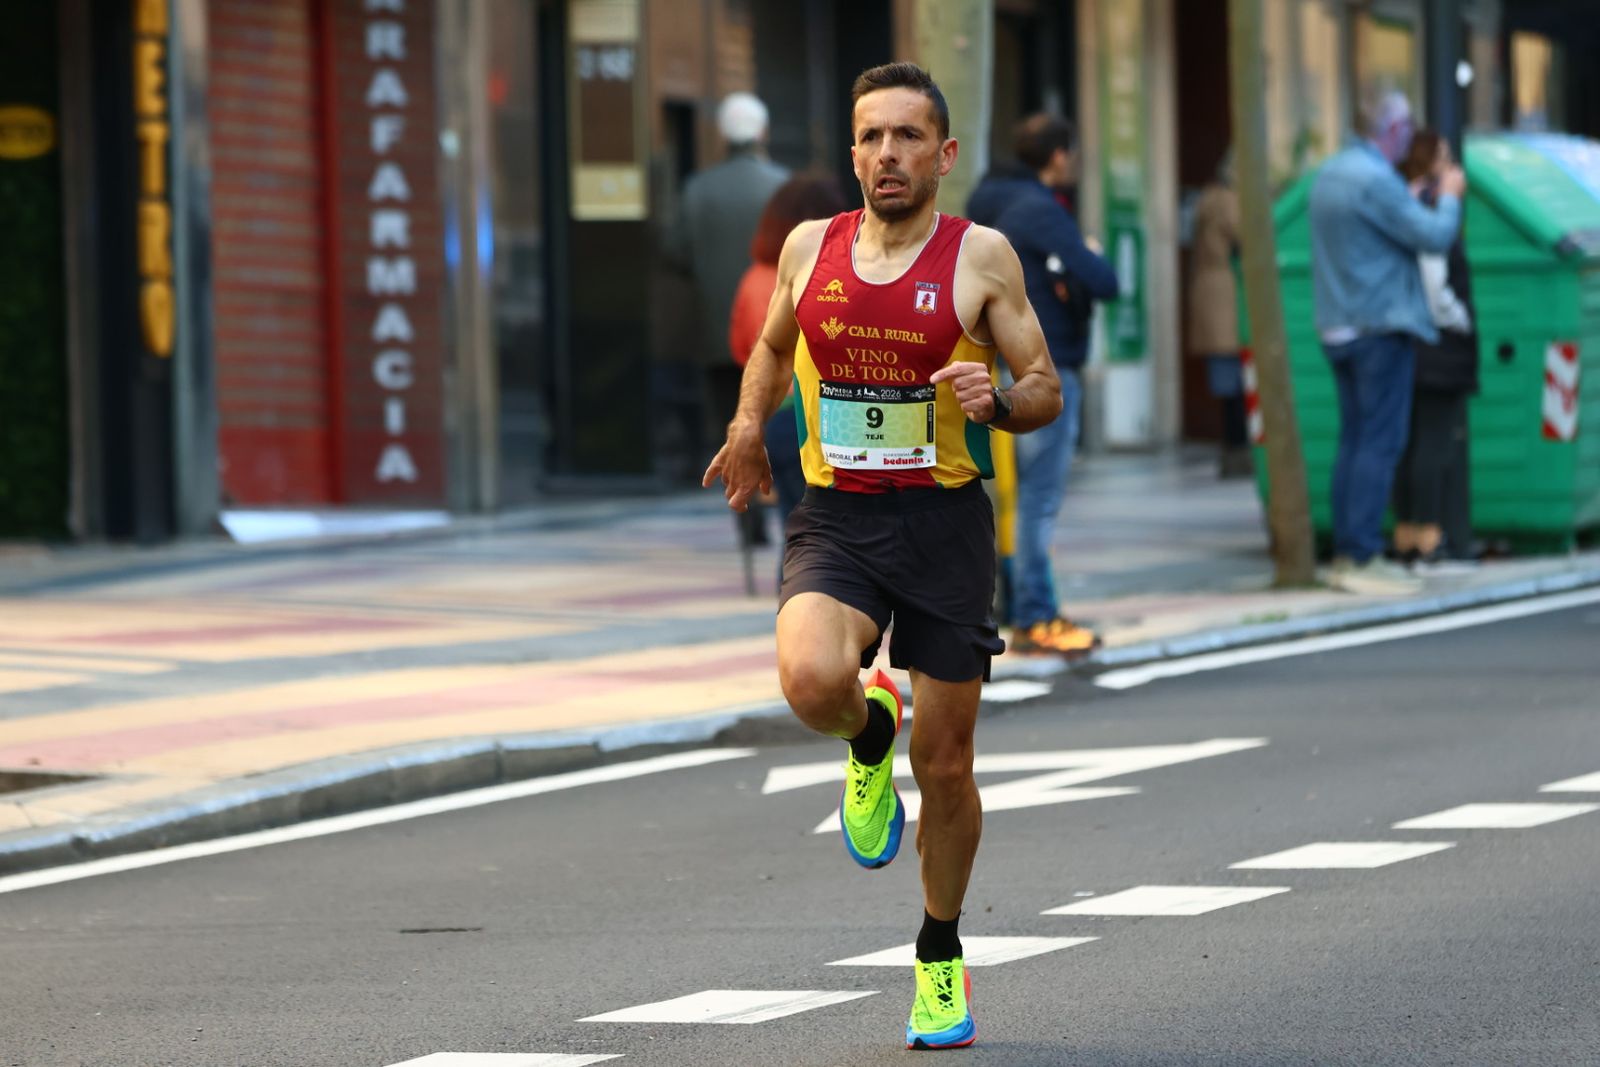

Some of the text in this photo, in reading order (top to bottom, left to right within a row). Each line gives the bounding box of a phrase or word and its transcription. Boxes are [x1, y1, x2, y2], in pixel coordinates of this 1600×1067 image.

[848, 326, 927, 344] CAJA RURAL
[845, 348, 898, 365] VINO
[830, 363, 916, 382] DE TORO
[881, 389, 901, 398] 2026
[866, 407, 884, 429] 9
